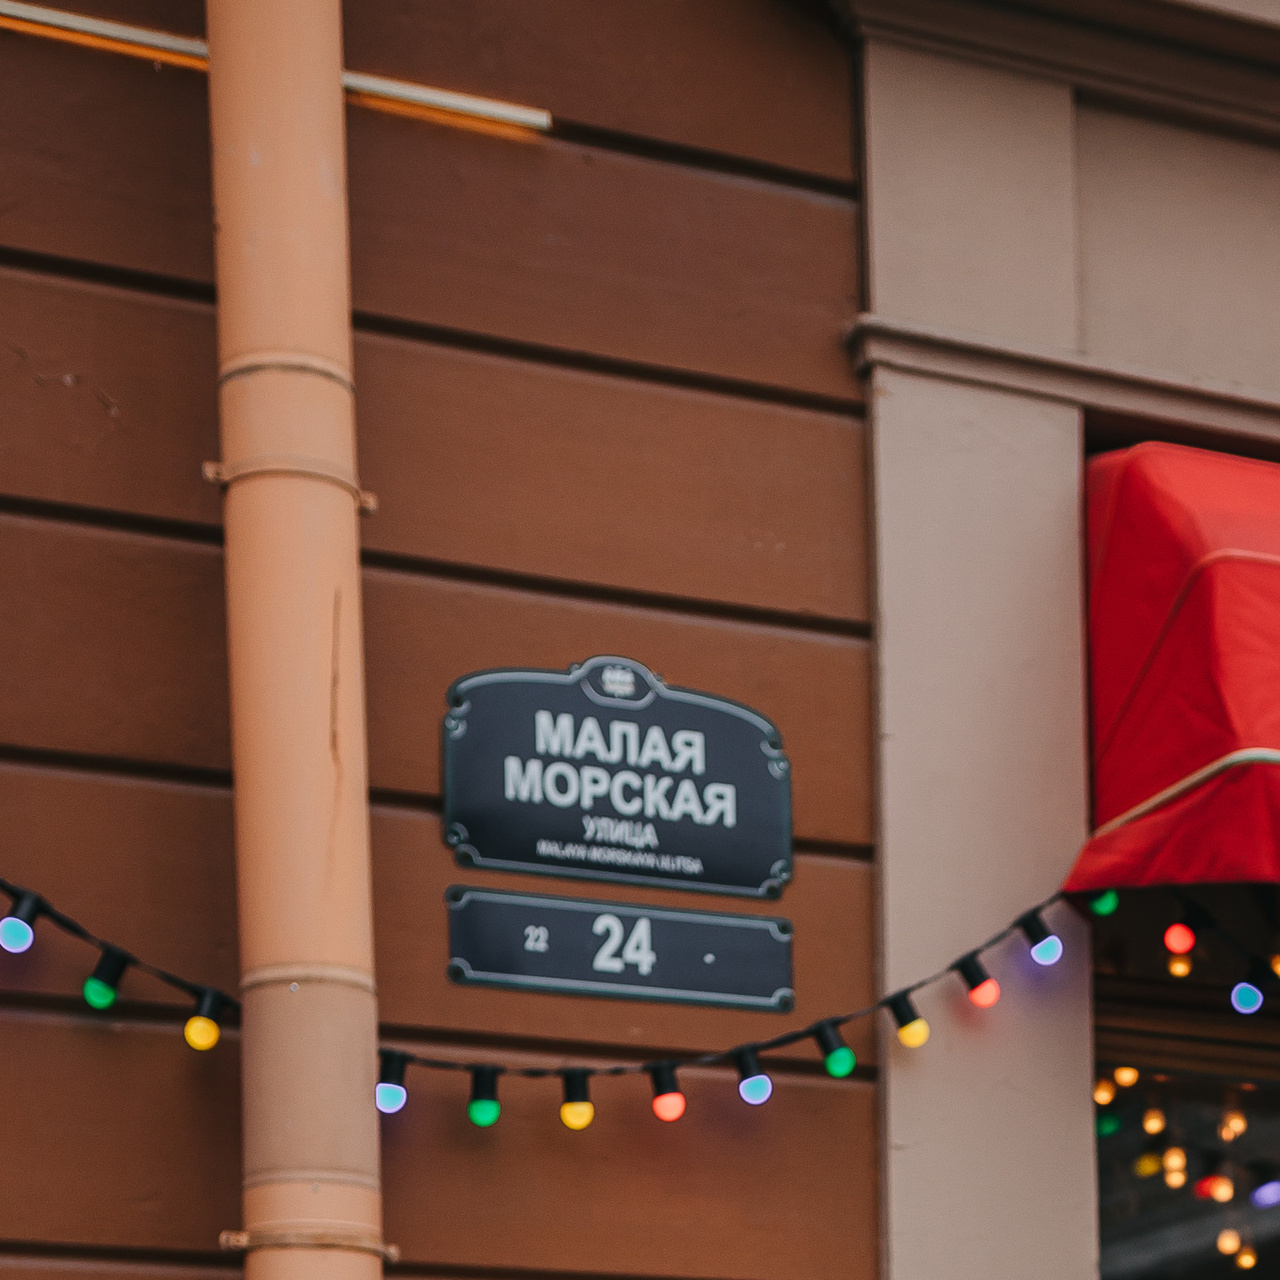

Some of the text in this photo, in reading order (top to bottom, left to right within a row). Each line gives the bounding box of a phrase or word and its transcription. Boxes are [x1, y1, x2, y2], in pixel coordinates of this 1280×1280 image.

[534, 708, 706, 775] МАЛАЯ
[504, 755, 738, 829] МОРСКАЯ
[581, 813, 660, 850] УЛИЦА
[523, 925, 549, 953] 22
[592, 913, 657, 976] 24
